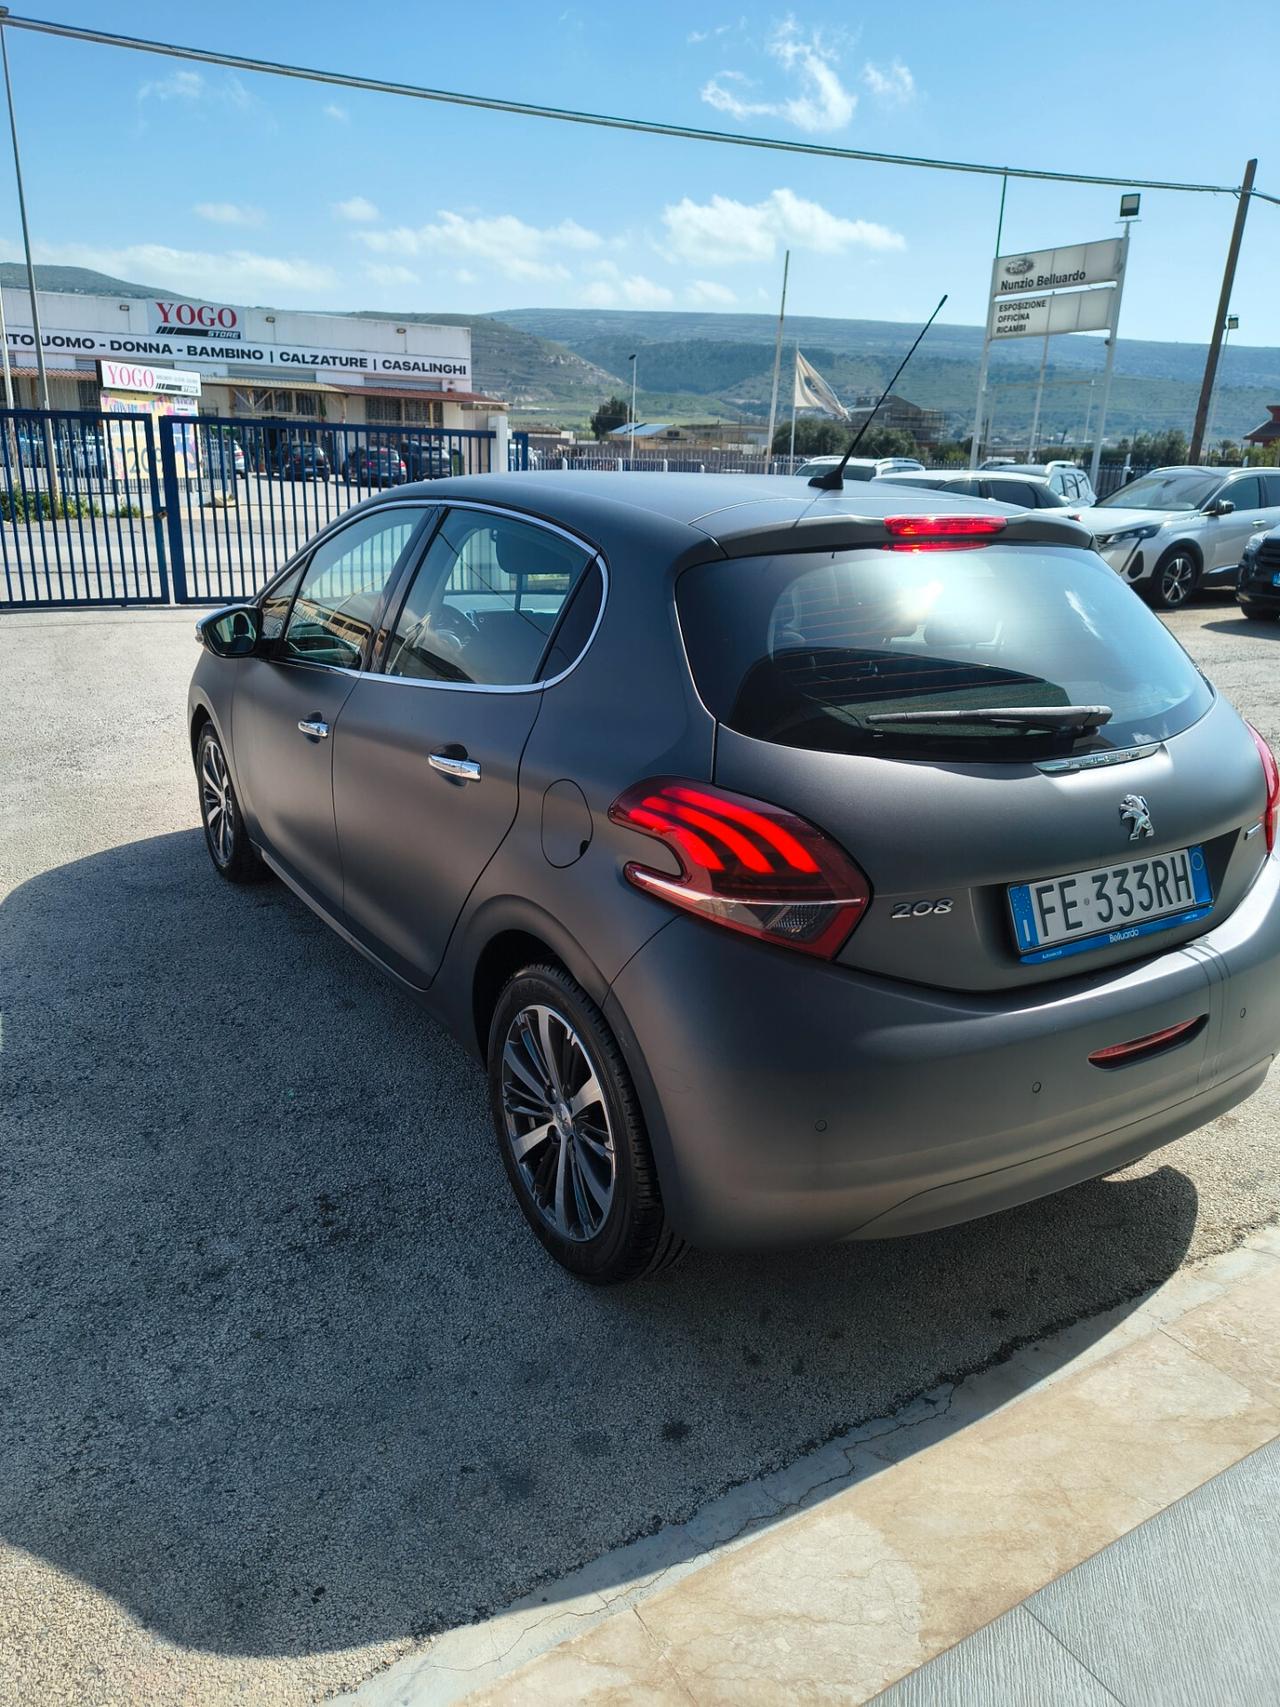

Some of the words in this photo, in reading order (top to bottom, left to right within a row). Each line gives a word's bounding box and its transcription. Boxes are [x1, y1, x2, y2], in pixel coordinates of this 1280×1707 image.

[1001, 277, 1034, 290] Nunzio
[1037, 270, 1086, 286] Belluardo
[155, 302, 237, 328] YOGO
[999, 300, 1046, 312] ESPOSIZIONE
[997, 313, 1030, 323] OFFICINA
[208, 330, 239, 339] STORE
[996, 324, 1026, 333] RICAMBI
[41, 335, 95, 350] UOMO
[110, 340, 173, 355] DONNA
[187, 345, 264, 360] BAMBINO
[279, 351, 368, 368] CALZATURE
[382, 359, 466, 375] CASALINGHI
[107, 364, 154, 389] YOGO
[1036, 879, 1083, 937] FE
[1091, 854, 1192, 923] 333RH
[891, 898, 954, 918] 208
[1109, 929, 1139, 943] Belluardo
